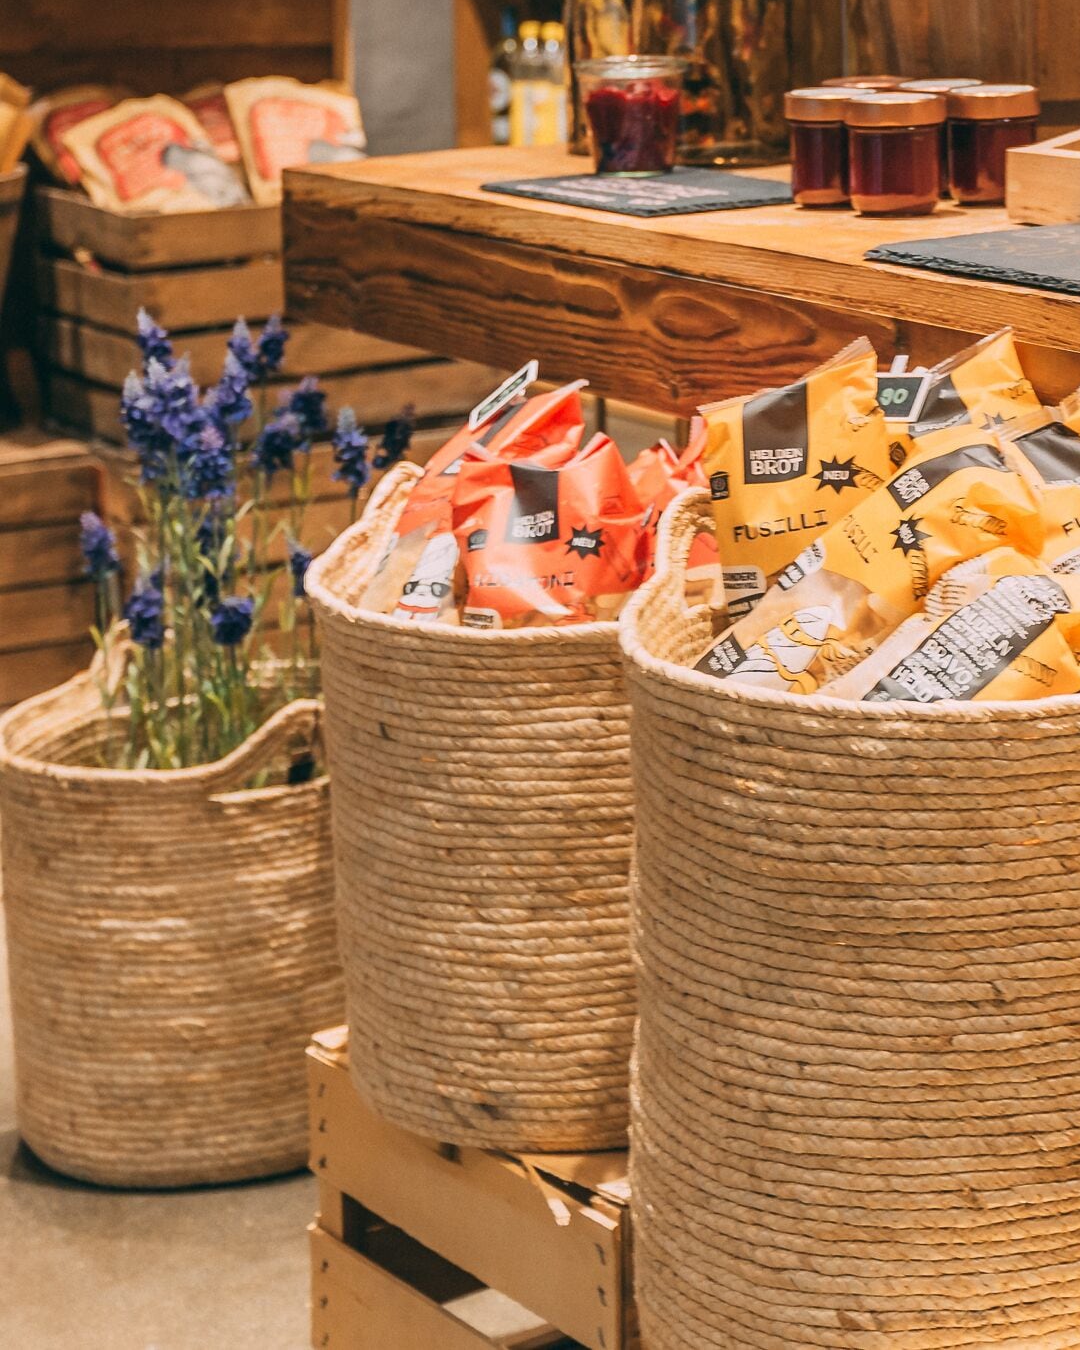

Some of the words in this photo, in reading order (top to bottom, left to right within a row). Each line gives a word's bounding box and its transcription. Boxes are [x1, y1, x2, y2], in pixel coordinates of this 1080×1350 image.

[749, 447, 803, 460] HELDEN
[751, 457, 804, 476] BROT
[822, 470, 850, 481] NEU
[512, 520, 555, 538] BROT
[732, 509, 829, 543] FUSILLI
